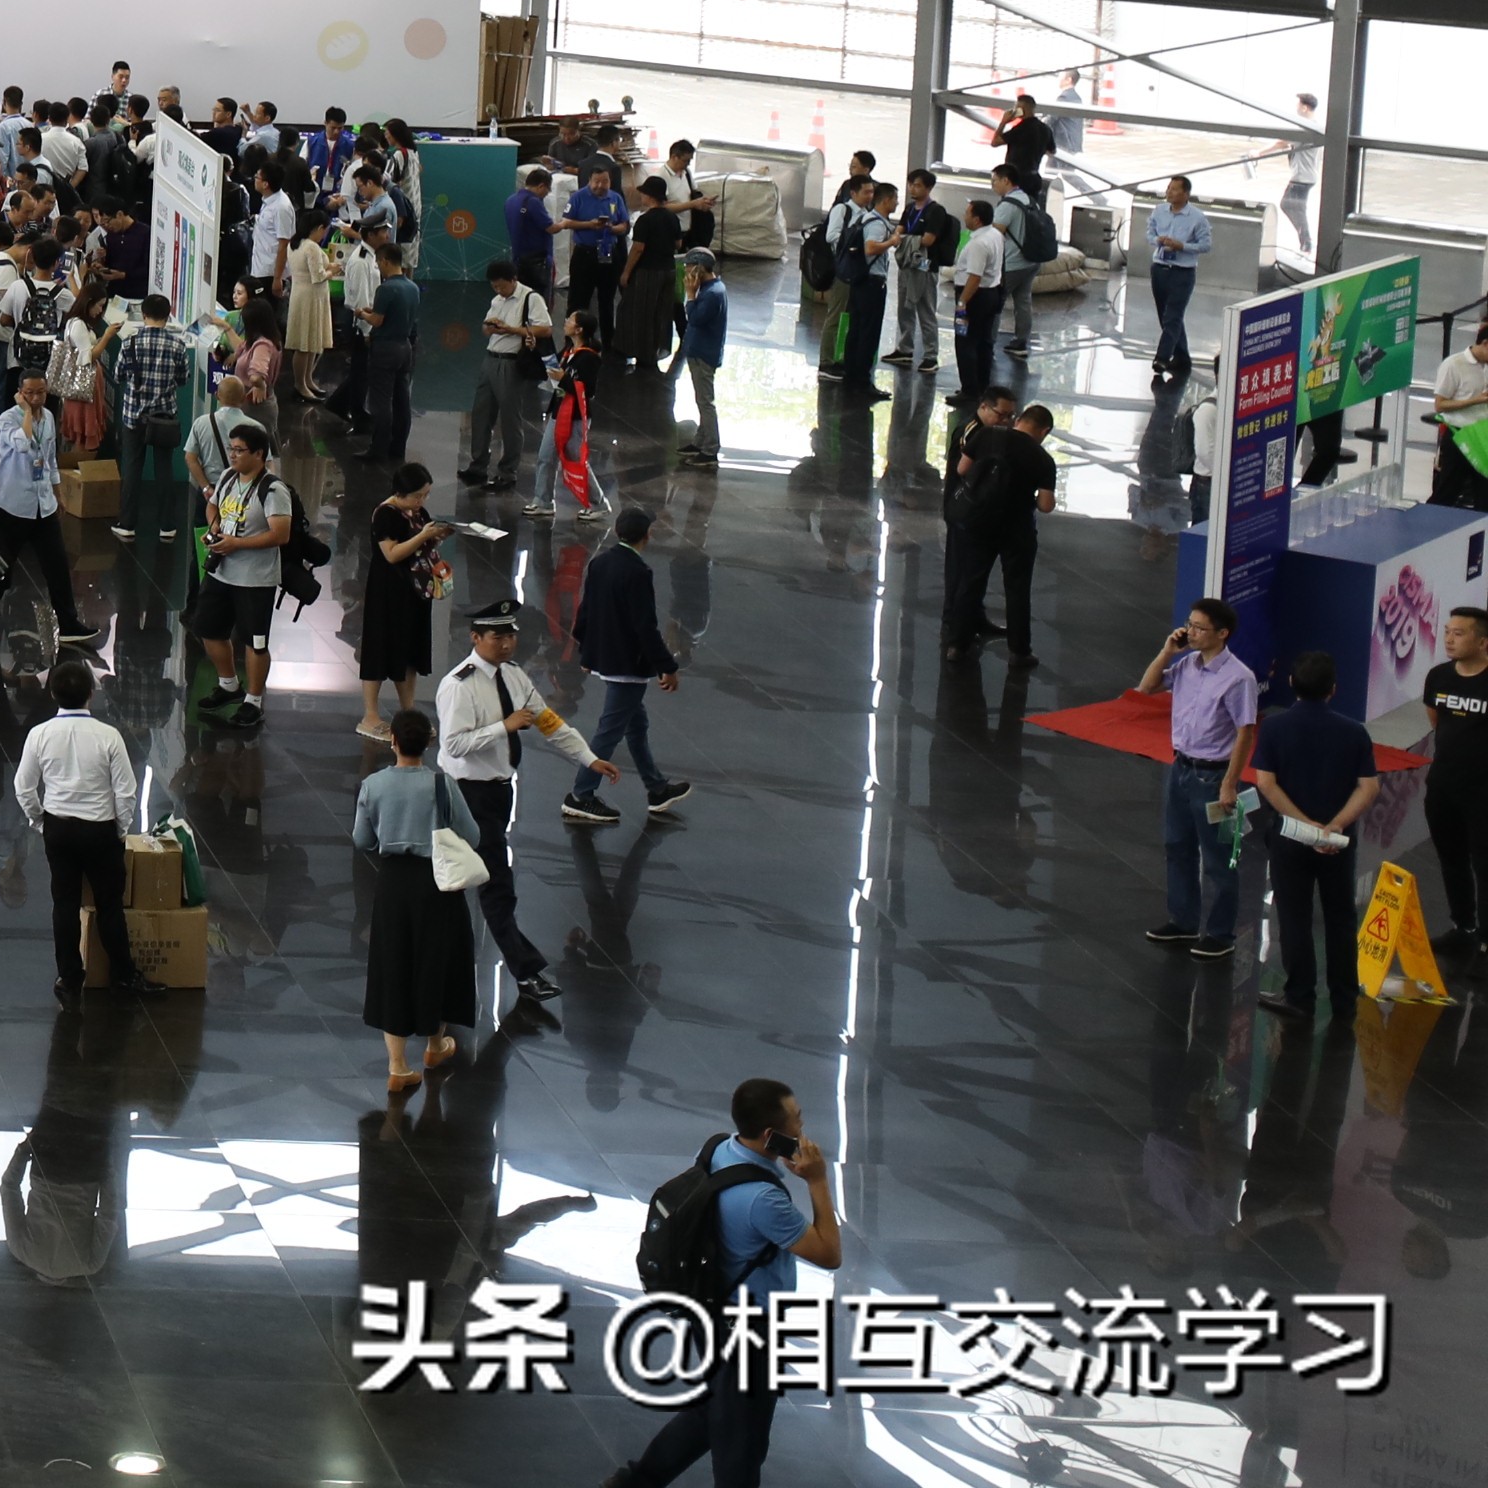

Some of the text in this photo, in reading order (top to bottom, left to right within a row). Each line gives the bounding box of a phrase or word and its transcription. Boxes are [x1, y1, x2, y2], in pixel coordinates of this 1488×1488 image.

[1239, 359, 1293, 396] 观众填表处
[1239, 396, 1252, 411] Form
[1253, 389, 1270, 406] Filling
[1270, 383, 1293, 400] Counter
[1379, 584, 1418, 659] 2019
[1435, 693, 1488, 714] FENDI
